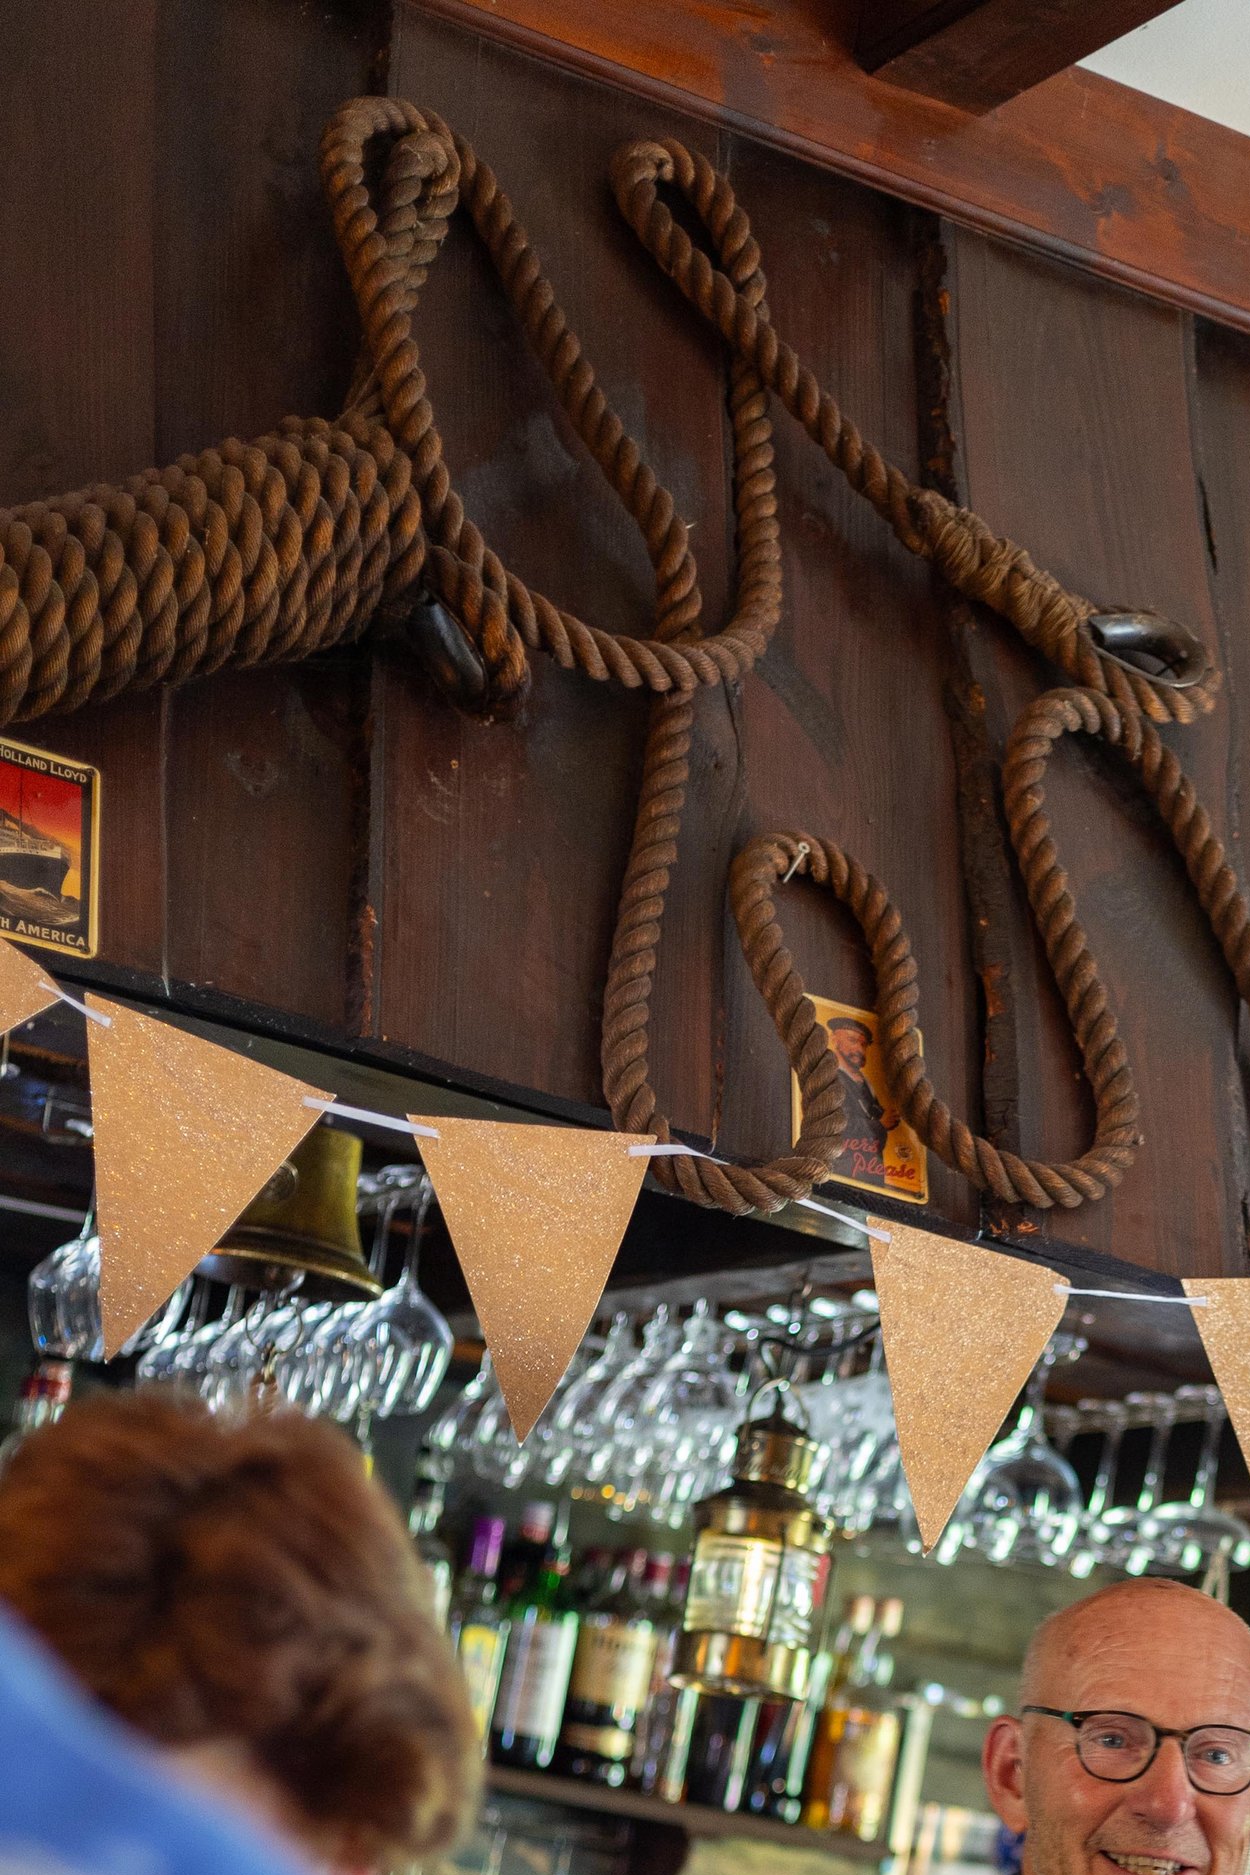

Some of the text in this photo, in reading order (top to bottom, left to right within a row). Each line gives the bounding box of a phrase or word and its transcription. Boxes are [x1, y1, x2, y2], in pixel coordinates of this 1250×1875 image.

[50, 761, 87, 783] LLOYD
[15, 919, 85, 947] AMERICA
[851, 1151, 915, 1180] Please
